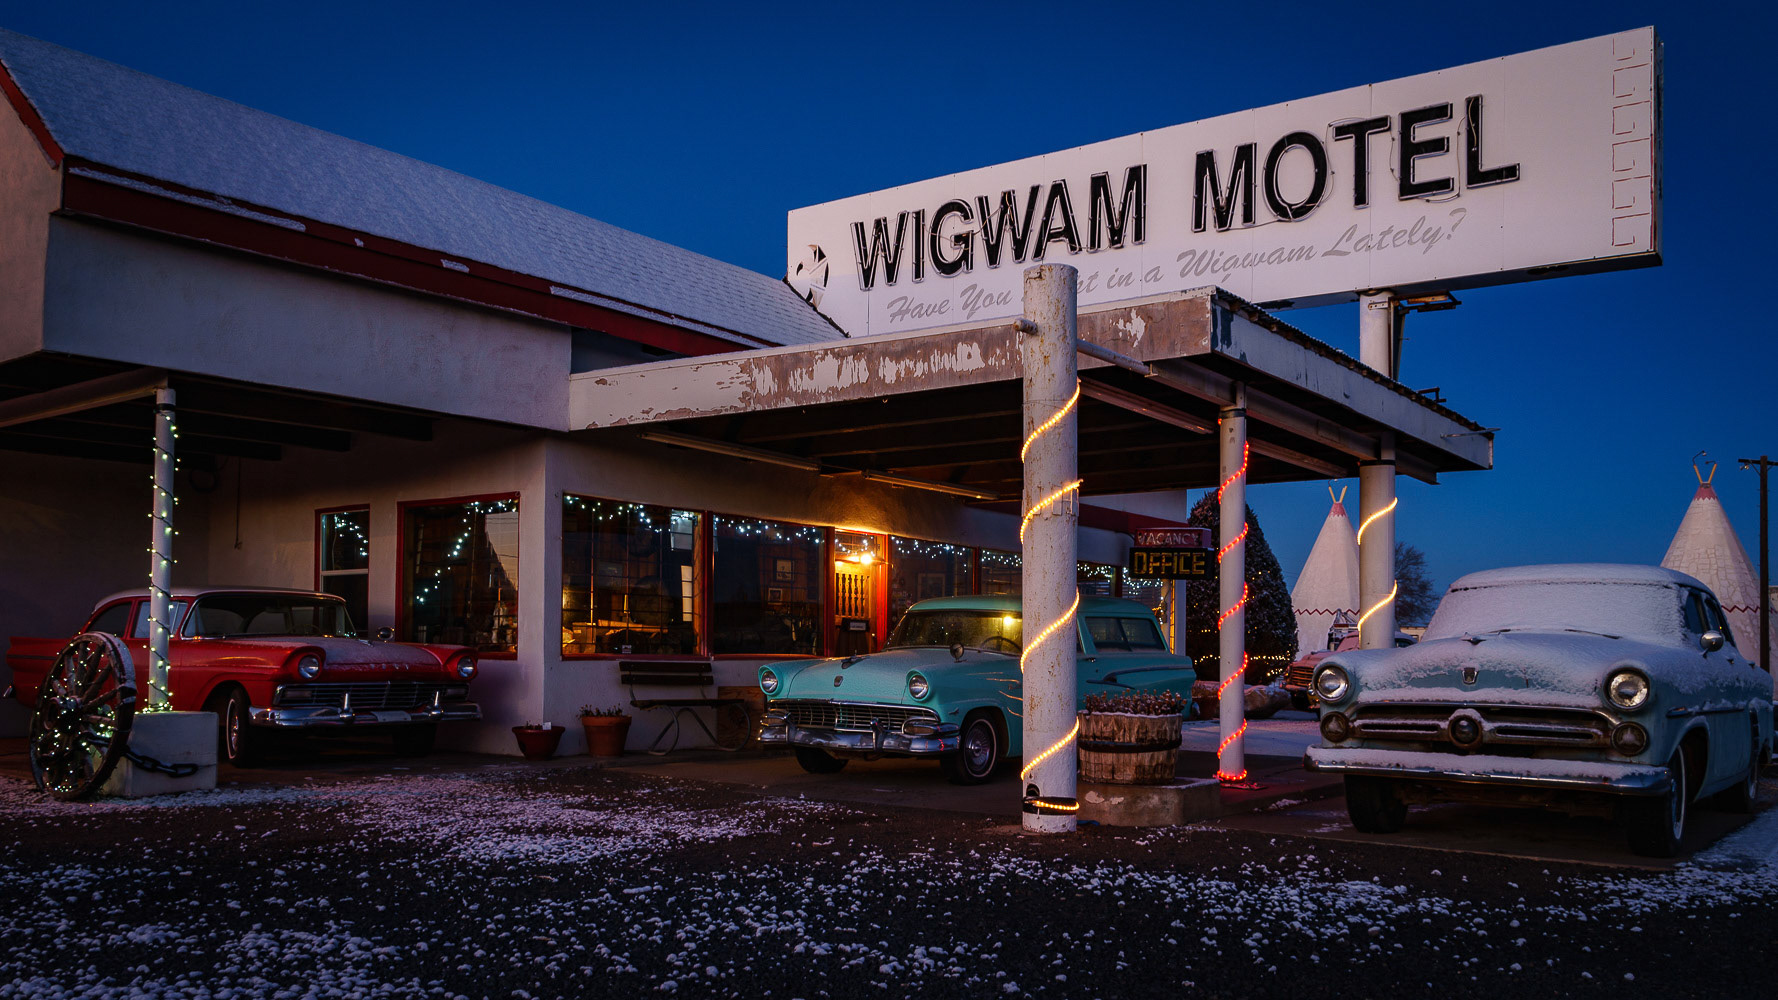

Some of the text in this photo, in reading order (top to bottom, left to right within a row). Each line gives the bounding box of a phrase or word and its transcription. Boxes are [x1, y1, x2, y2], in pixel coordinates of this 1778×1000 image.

[850, 94, 1521, 292] WIGWAM MOTEL
[887, 296, 950, 323] Have
[960, 284, 1012, 320] You
[1107, 267, 1135, 289] in
[1144, 266, 1164, 283] a
[1177, 244, 1317, 283] Wigwam
[1321, 207, 1467, 270] Lately?
[1134, 552, 1205, 575] OFFICE
[1137, 532, 1199, 545] VACANCY
